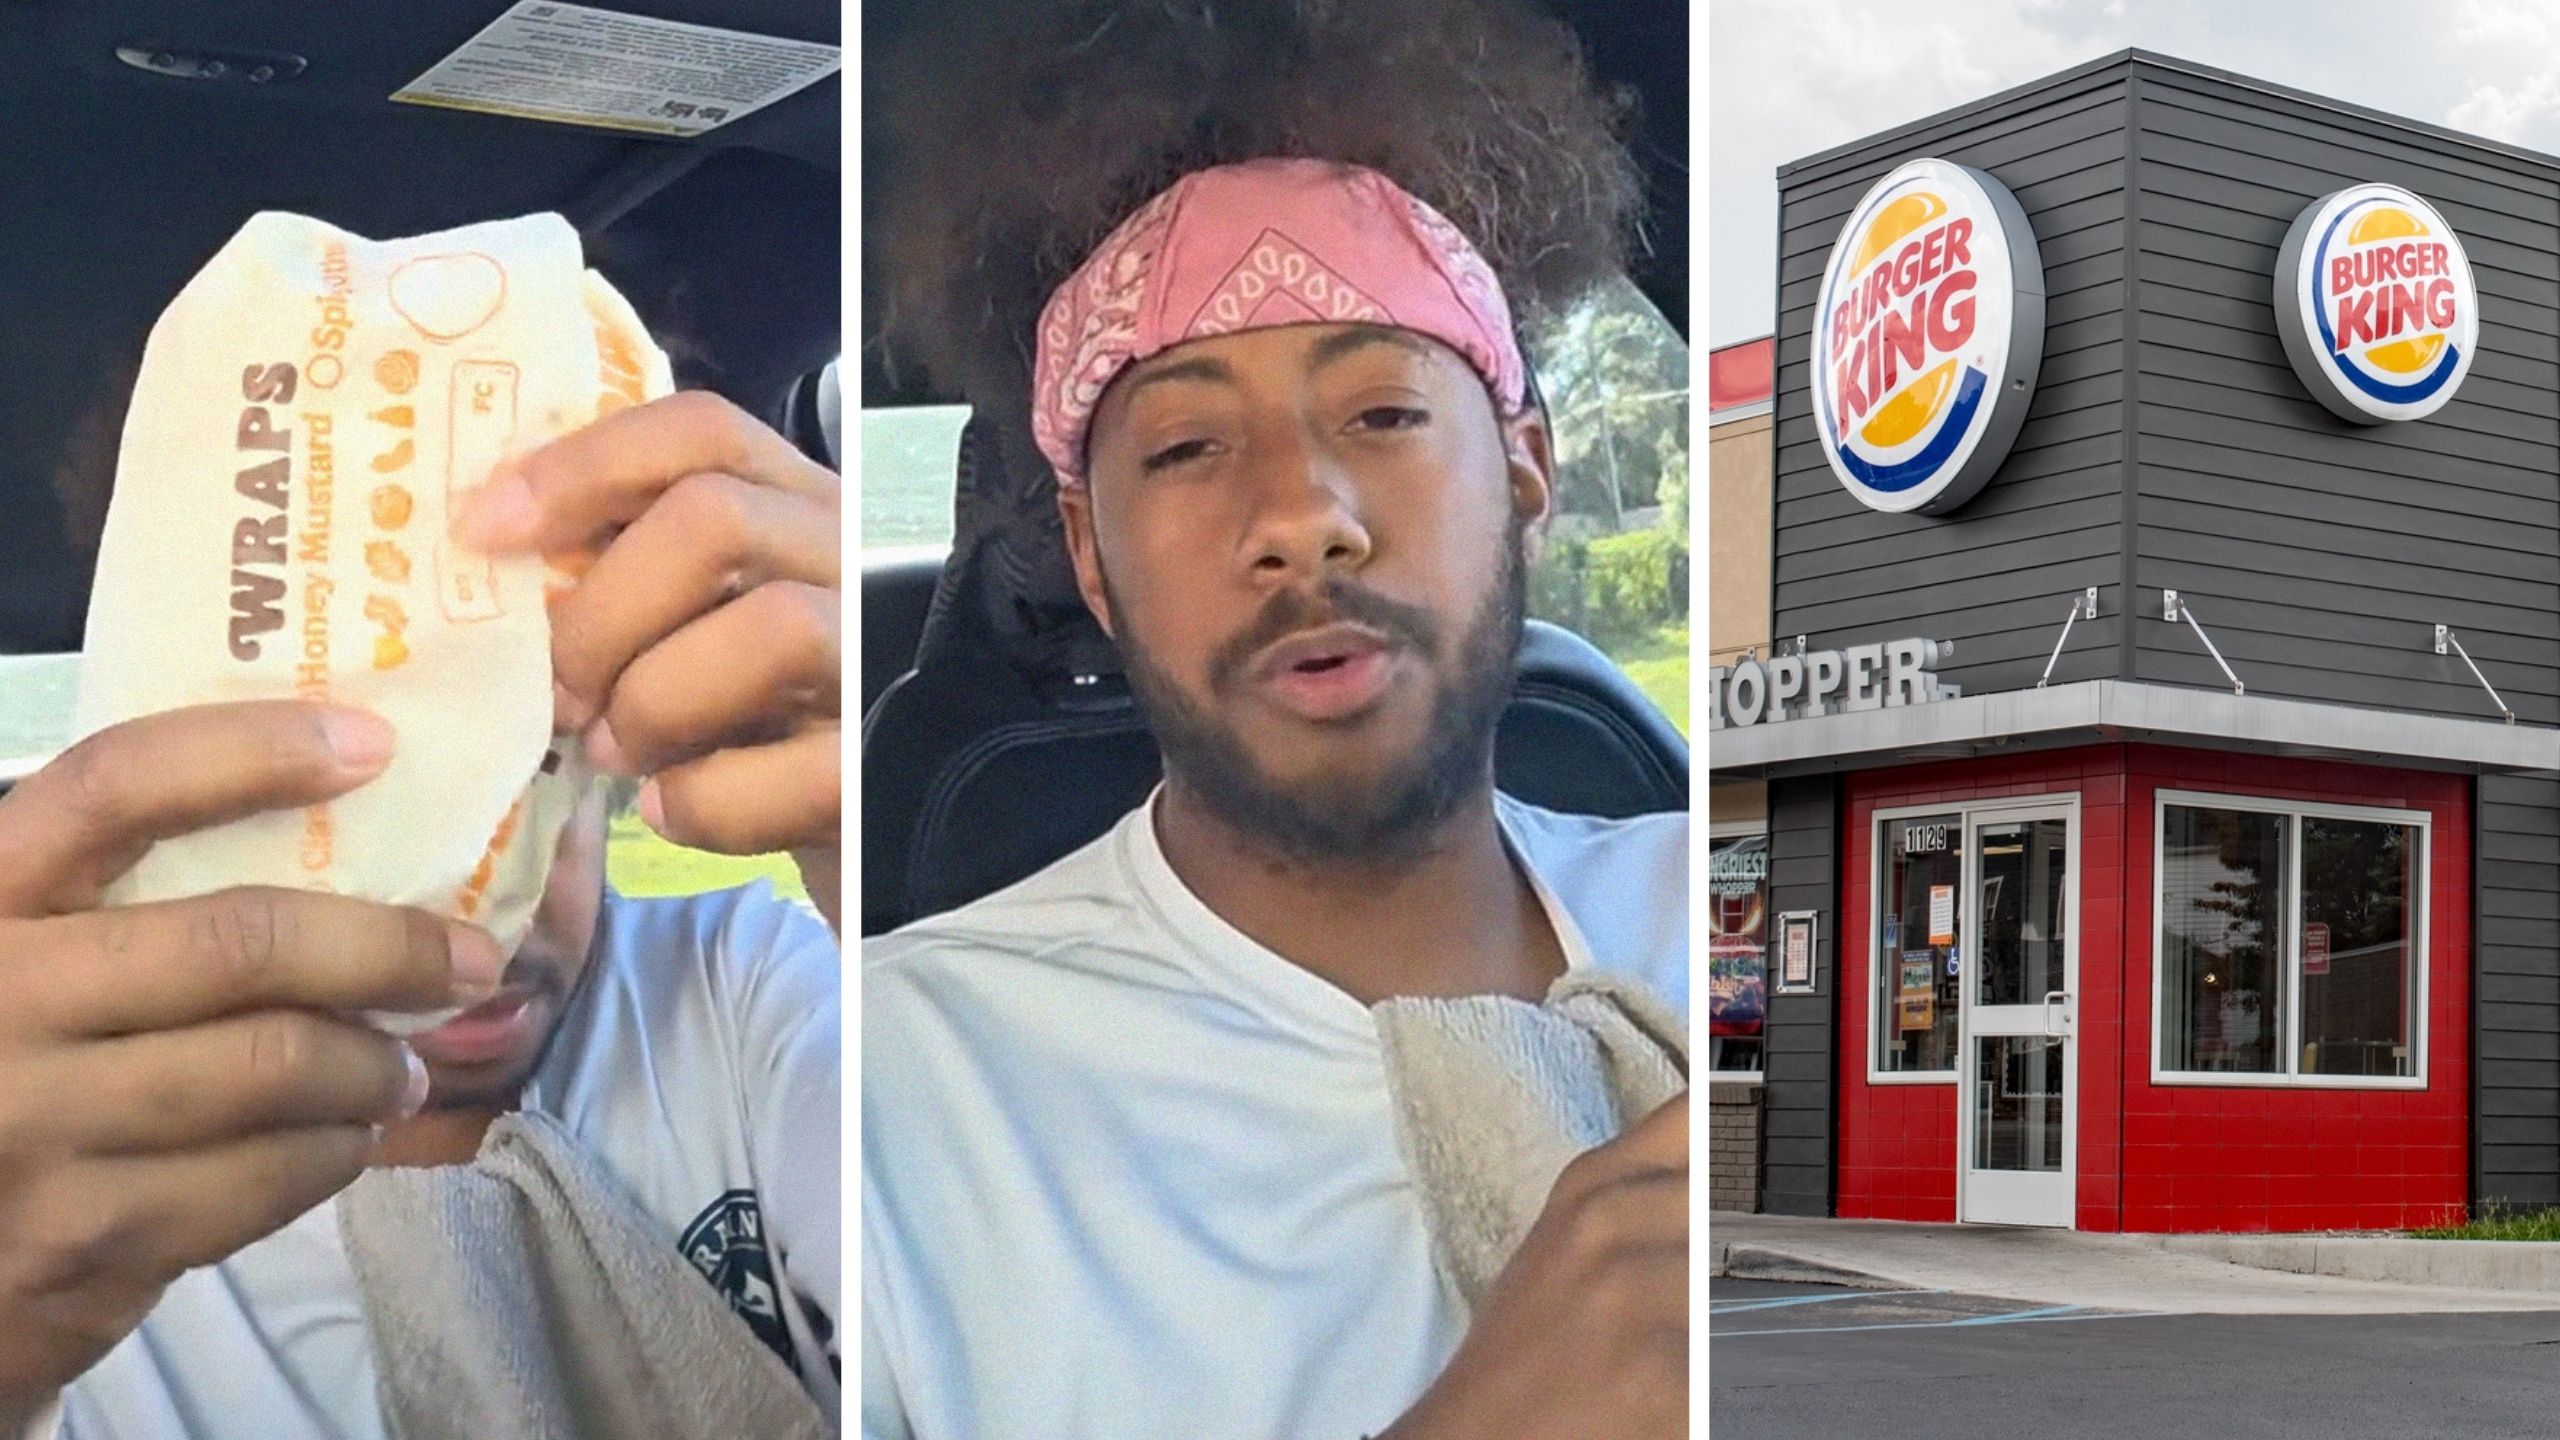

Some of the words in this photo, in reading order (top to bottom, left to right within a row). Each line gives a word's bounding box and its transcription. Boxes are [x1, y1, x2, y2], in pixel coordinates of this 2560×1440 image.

[1832, 217, 1973, 365] BURGER
[2331, 242, 2450, 297] BURGER
[2336, 278, 2456, 352] KING
[1836, 269, 1978, 442] KING
[228, 361, 299, 662] WRAPS
[298, 411, 334, 563] Mustard
[295, 571, 336, 689] Honey
[1906, 824, 1946, 852] 1129
